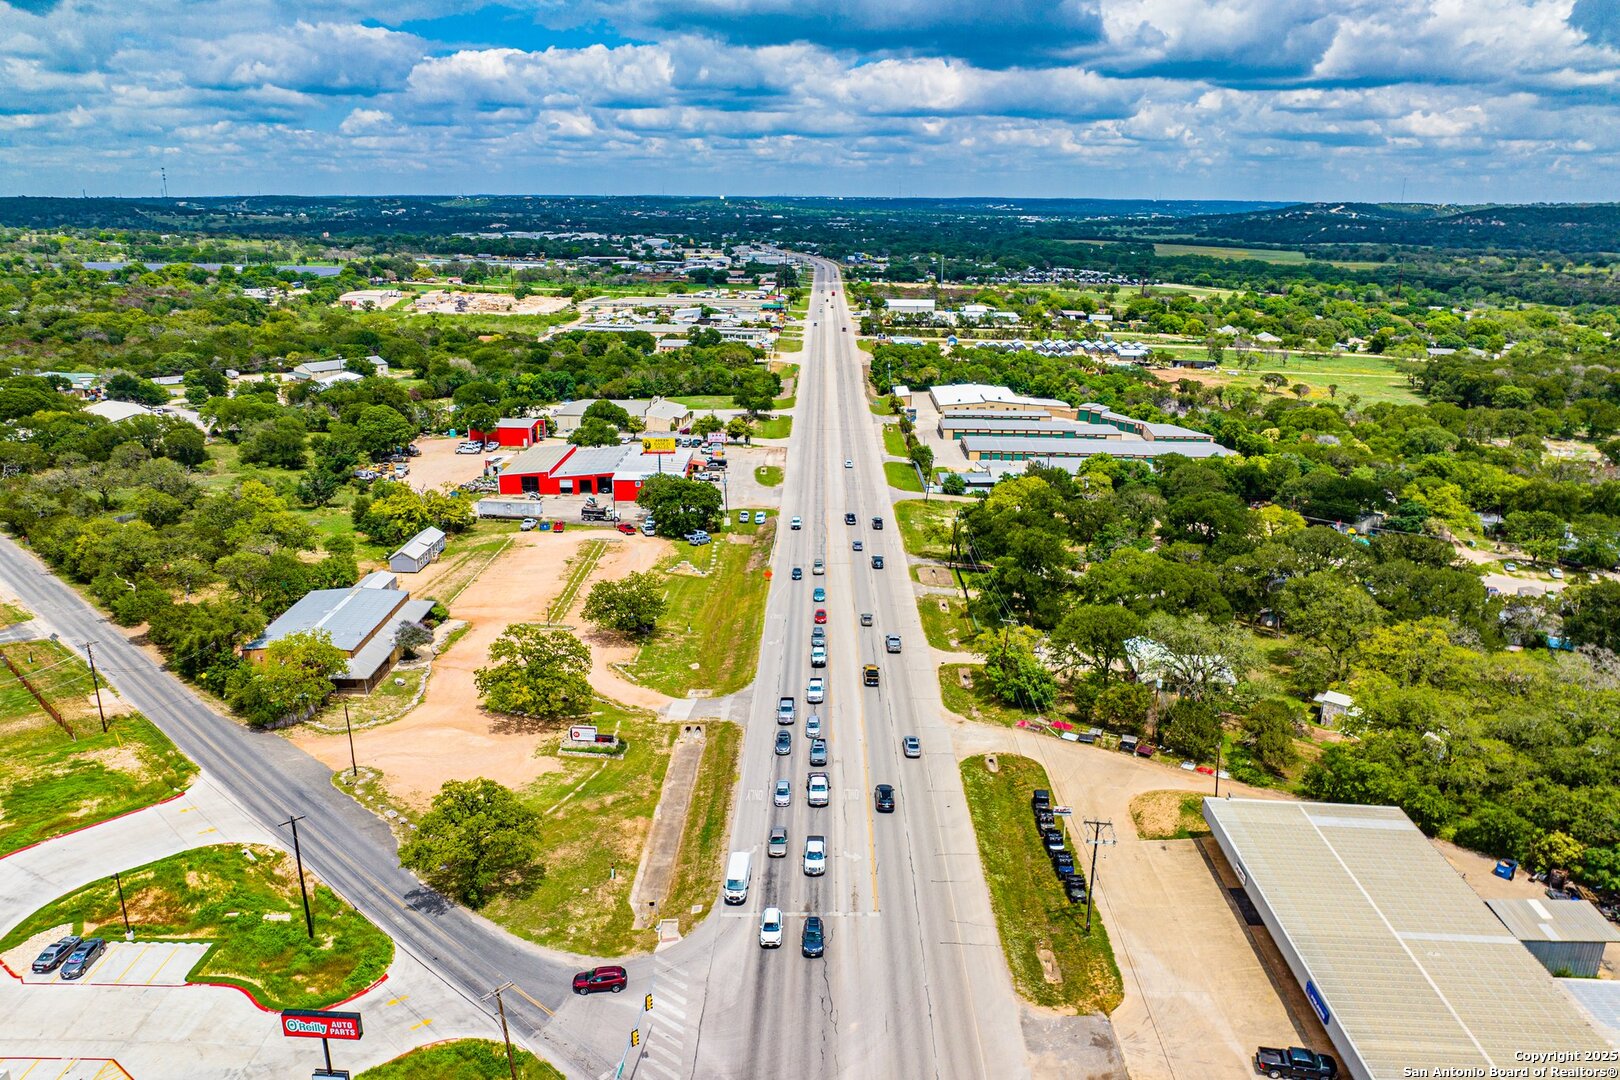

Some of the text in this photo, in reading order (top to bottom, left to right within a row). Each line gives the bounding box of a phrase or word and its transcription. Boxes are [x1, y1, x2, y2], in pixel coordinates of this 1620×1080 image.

[286, 1019, 327, 1034] O'Reilly
[331, 1021, 353, 1029] AUTO
[330, 1028, 355, 1036] PARTS
